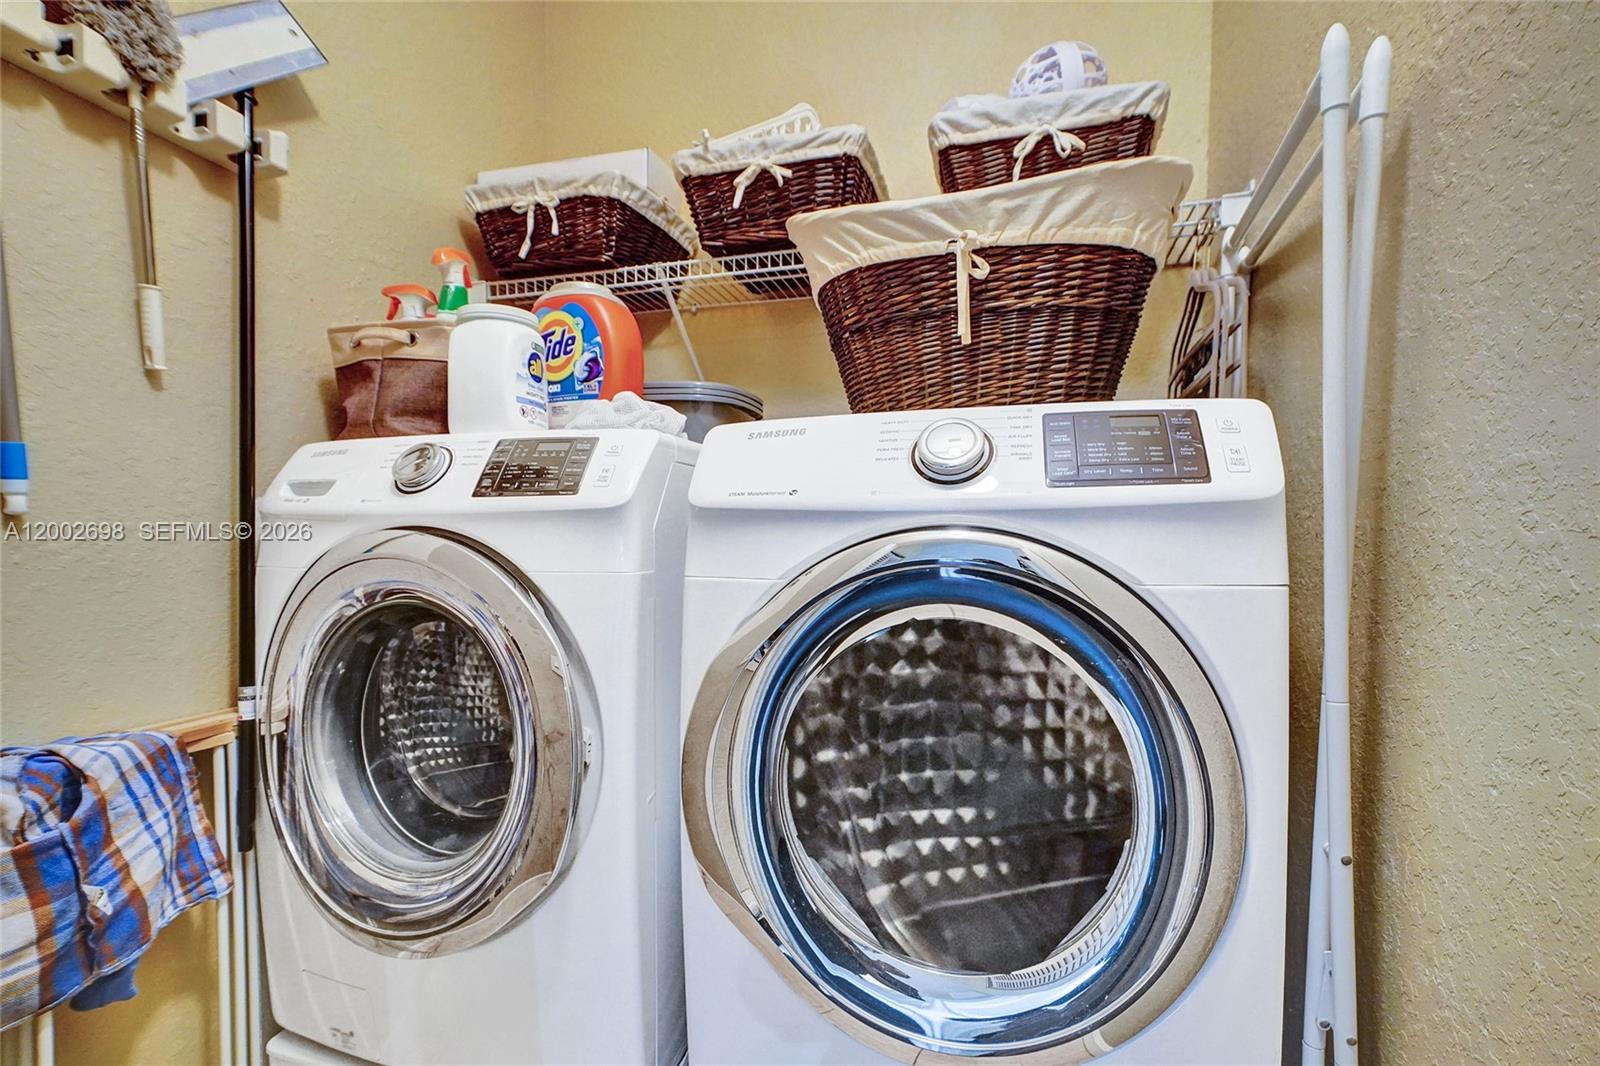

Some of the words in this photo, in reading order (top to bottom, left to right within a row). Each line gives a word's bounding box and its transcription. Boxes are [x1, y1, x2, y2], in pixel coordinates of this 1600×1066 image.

[541, 327, 577, 363] Tide
[529, 358, 543, 378] all
[747, 427, 808, 441] SAMSUNG
